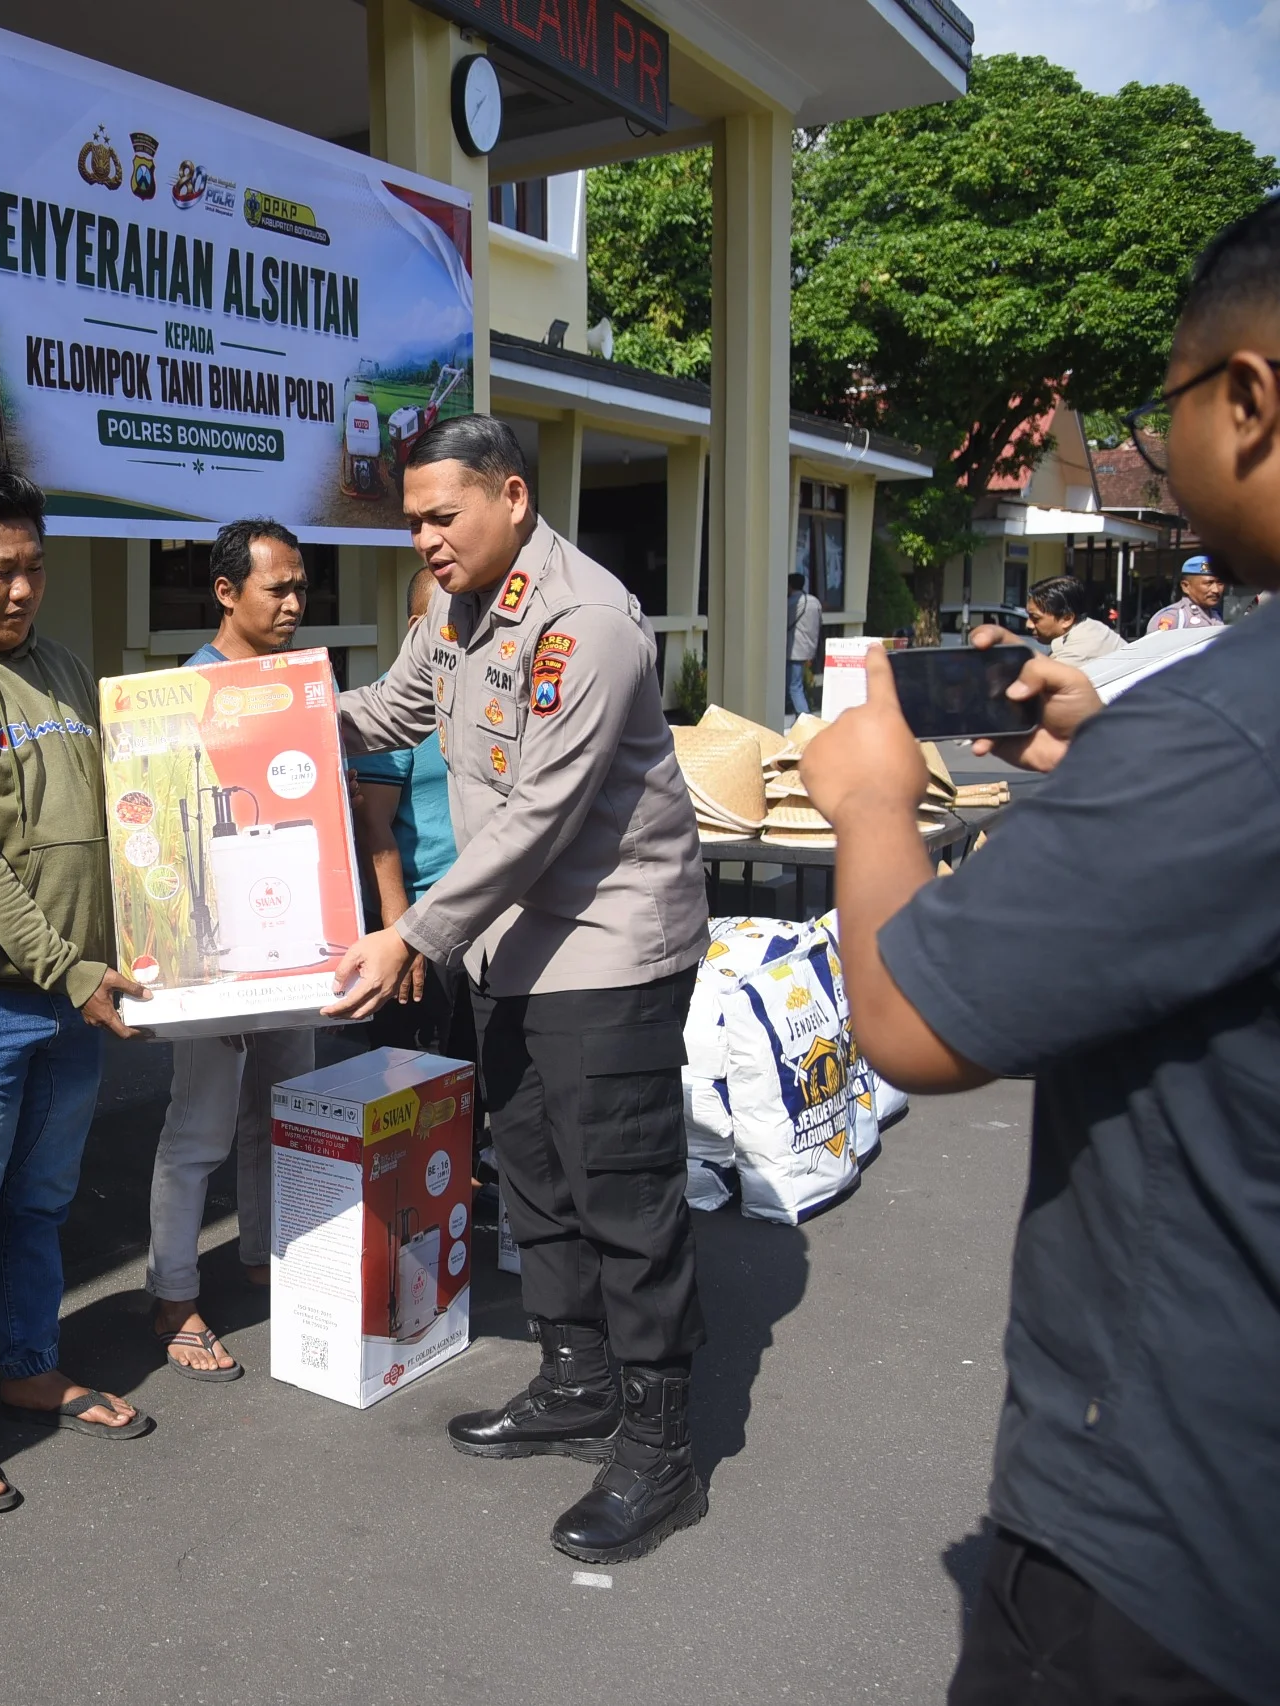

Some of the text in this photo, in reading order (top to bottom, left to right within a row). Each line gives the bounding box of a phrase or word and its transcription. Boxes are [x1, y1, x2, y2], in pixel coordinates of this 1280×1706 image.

[205, 187, 236, 209] POLRI
[263, 196, 298, 218] DPKP
[223, 248, 359, 339] ALSINTAN
[165, 321, 215, 355] KEPADA
[26, 335, 335, 423] KELOMPOK TANI BINAAN POLRI
[107, 417, 277, 454] POLRES BONDOWOSO
[538, 635, 571, 649] OLRES
[432, 647, 457, 671] ARYO
[485, 666, 512, 692] POLRI
[135, 683, 194, 710] SWAN
[304, 684, 325, 700] SNI
[271, 765, 287, 776] BE
[297, 762, 311, 773] 16
[255, 895, 282, 908] SWAN
[786, 999, 830, 1042] JENDERAL
[382, 1106, 412, 1130] SWAN
[280, 1122, 349, 1143] PETUNJUK PENGGUNAAN
[284, 1131, 346, 1149] INSTRUCTIONS TO USE
[289, 1140, 299, 1149] BE
[792, 1120, 834, 1152] JAGUNG
[428, 1165, 436, 1176] BE
[441, 1160, 449, 1170] 16
[415, 1344, 436, 1362] GOLDEN
[436, 1336, 450, 1350] AGIN
[449, 1328, 463, 1343] NUSA
